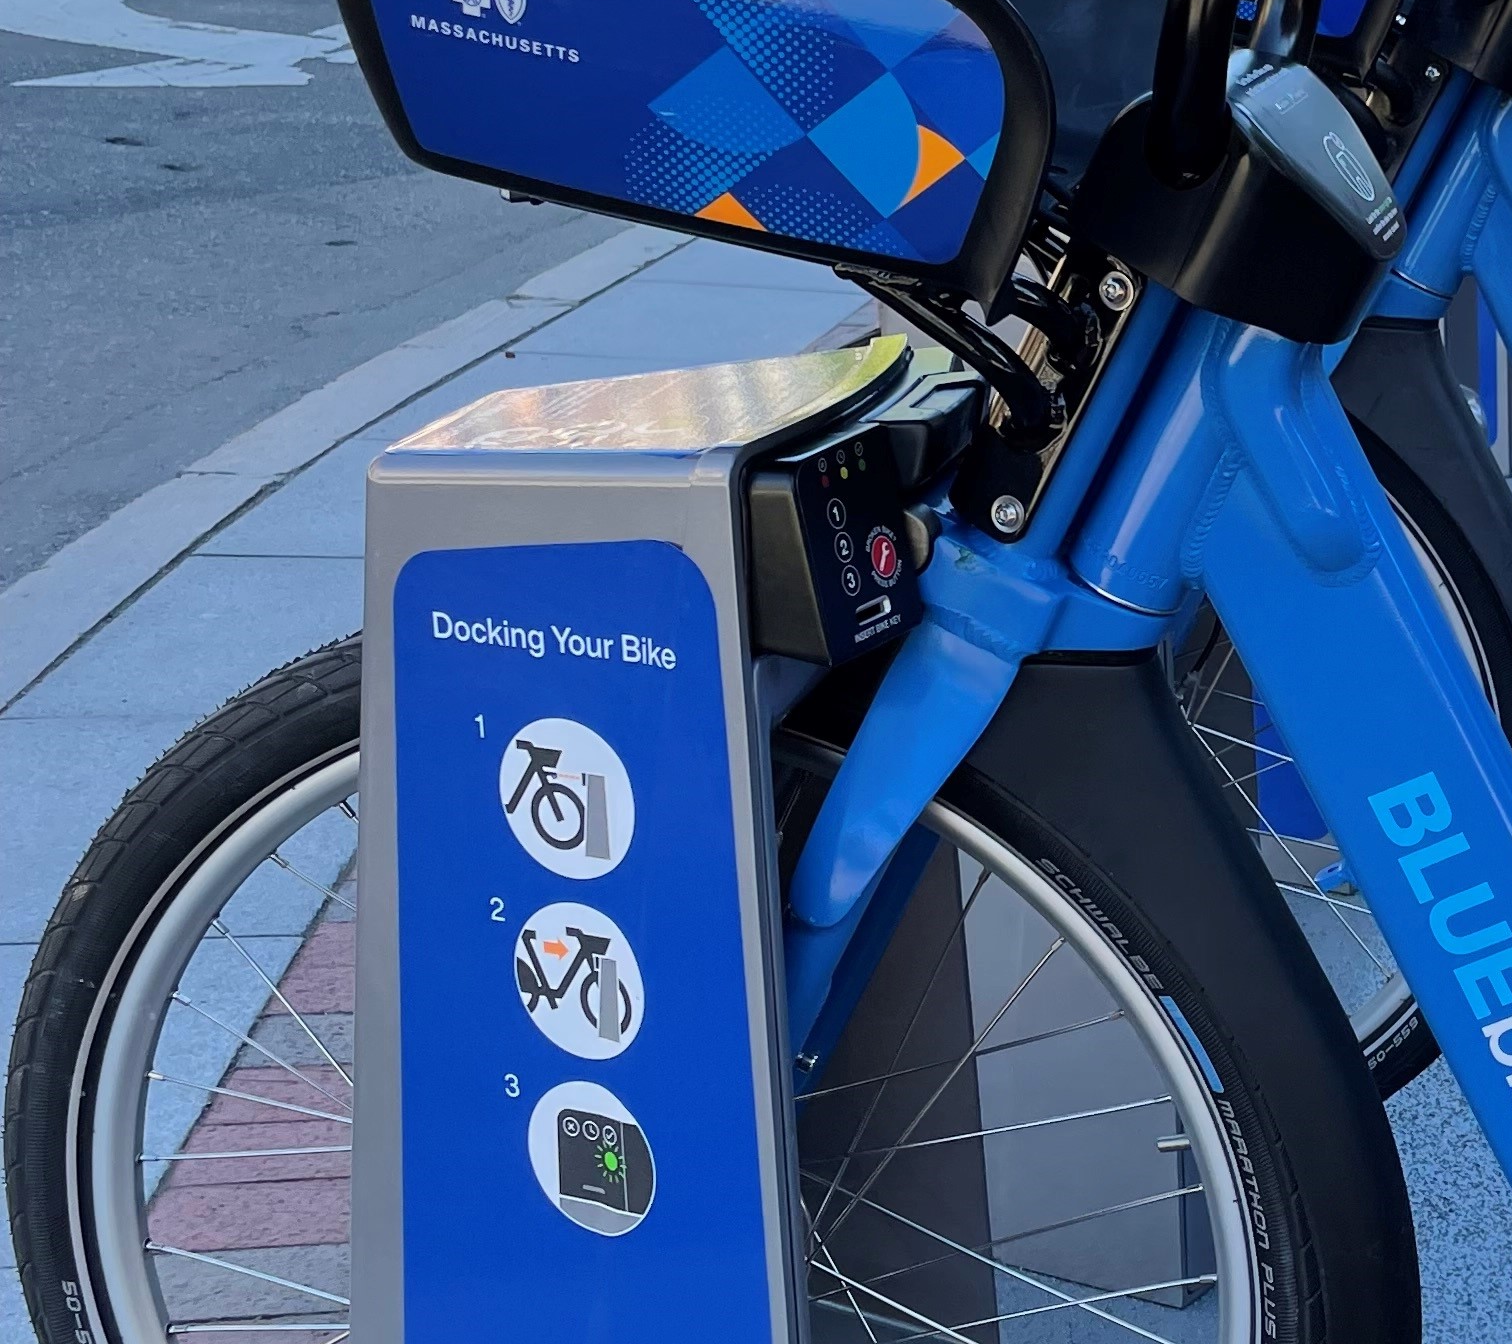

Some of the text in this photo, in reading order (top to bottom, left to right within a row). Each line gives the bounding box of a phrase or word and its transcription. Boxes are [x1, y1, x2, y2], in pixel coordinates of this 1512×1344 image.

[410, 13, 581, 64] MASSACHUSETTS
[832, 506, 840, 522] 1
[839, 539, 850, 556] 2
[846, 572, 856, 589] 3
[431, 611, 677, 670] Docking Your Bike
[854, 613, 902, 644] INSERT BIKE KEY
[474, 714, 487, 740] 1
[489, 897, 507, 923] 2
[1035, 857, 1165, 991] SCHWALBE
[1366, 1015, 1419, 1071] 50-559
[503, 1072, 521, 1098] 3
[1216, 1098, 1277, 1340] MARATHON PLUS
